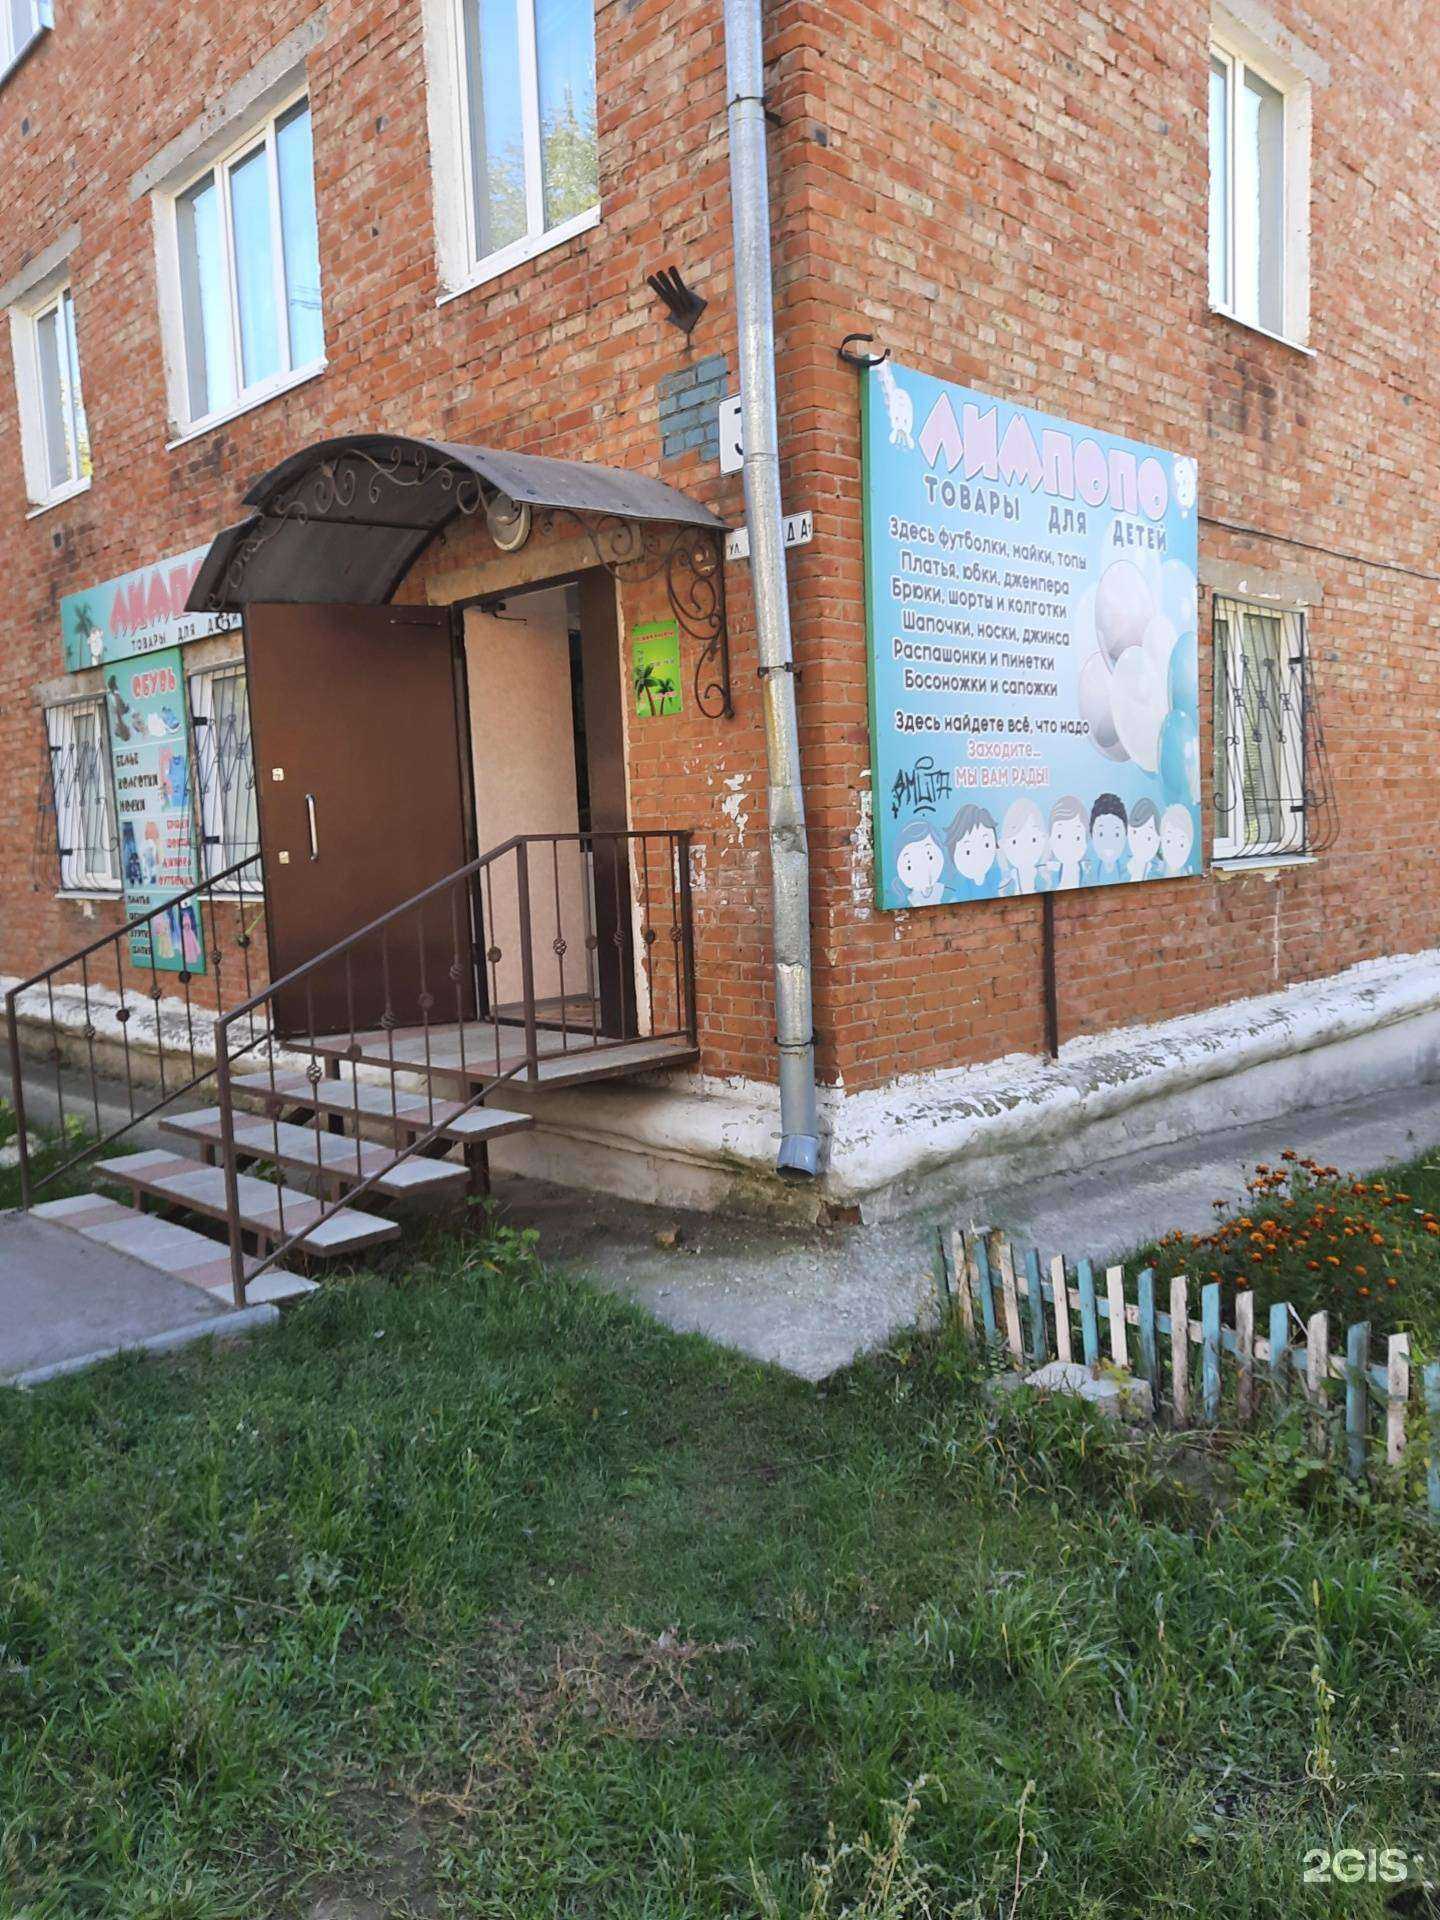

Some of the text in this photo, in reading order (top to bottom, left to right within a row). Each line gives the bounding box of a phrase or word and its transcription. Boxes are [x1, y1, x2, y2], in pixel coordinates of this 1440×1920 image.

[918, 391, 1168, 521] ЛИМПОПО
[924, 476, 1167, 551] ТОВАРЫ ДЛЯ ДЕТЕЙ
[890, 516, 935, 543] Здесь
[939, 526, 1009, 558] футболки,
[1057, 552, 1087, 570] топы
[901, 551, 959, 580] Платья,
[962, 563, 1000, 586] юбки,
[892, 577, 1067, 618] Брюки, шорты и колготки
[131, 632, 166, 650] ТОВАРЫ
[177, 623, 196, 642] ДЛЯ
[903, 610, 1070, 647] Шапочки, носки, джинса
[893, 638, 1055, 671] Распашонки и пинетки
[133, 669, 175, 697] ОБУВЬ
[905, 669, 1058, 696] Босоножки и сапожки
[896, 711, 1090, 736] Здесь найдете всё, что надо
[956, 768, 978, 786] МЫ
[982, 767, 1008, 787] ВАМ
